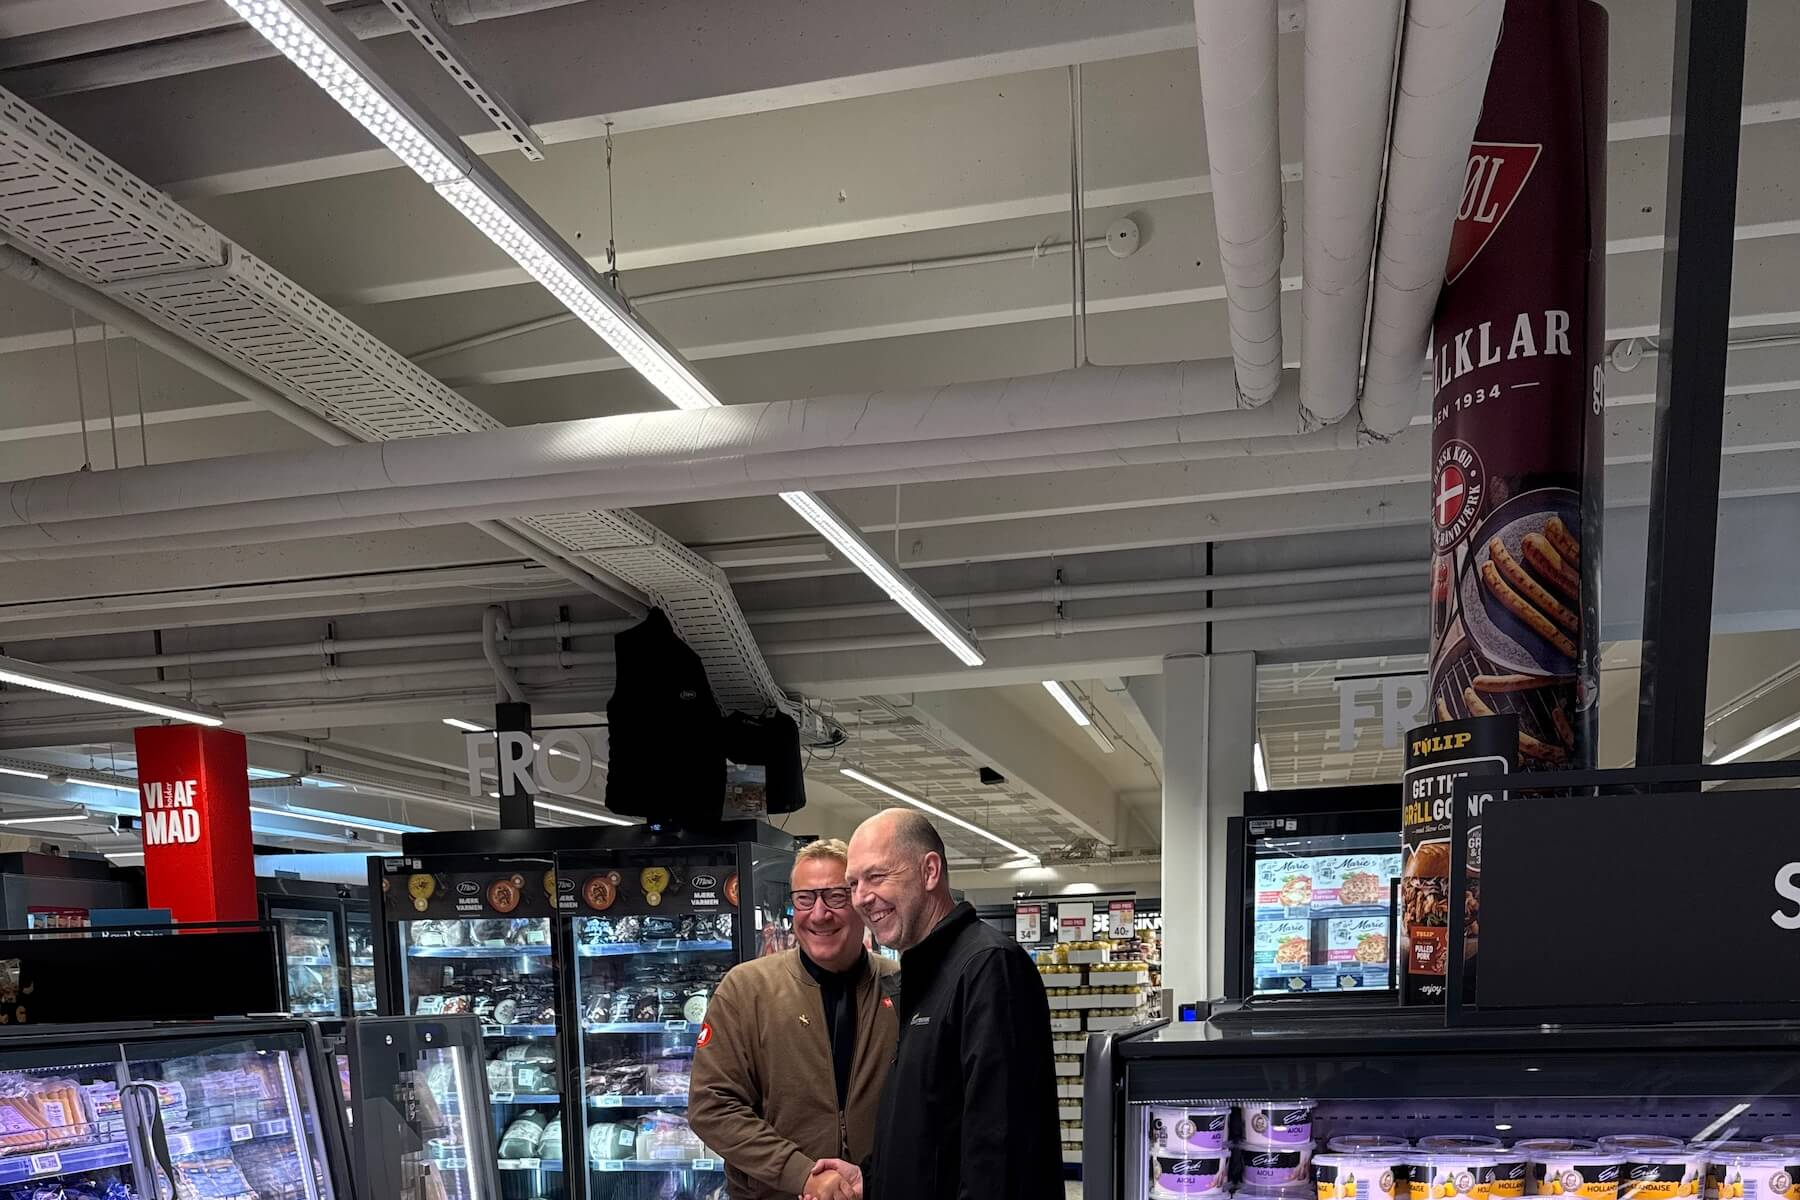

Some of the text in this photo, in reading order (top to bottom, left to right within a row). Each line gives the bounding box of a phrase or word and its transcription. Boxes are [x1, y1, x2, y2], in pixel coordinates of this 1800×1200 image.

[1454, 384, 1501, 411] 1934
[1412, 732, 1471, 757] TULIP
[465, 731, 593, 797] FRO
[143, 782, 164, 809] VI
[174, 780, 197, 807] AF
[1413, 772, 1468, 799] GET TH
[145, 809, 200, 845] MAD
[1771, 861, 1800, 930] S
